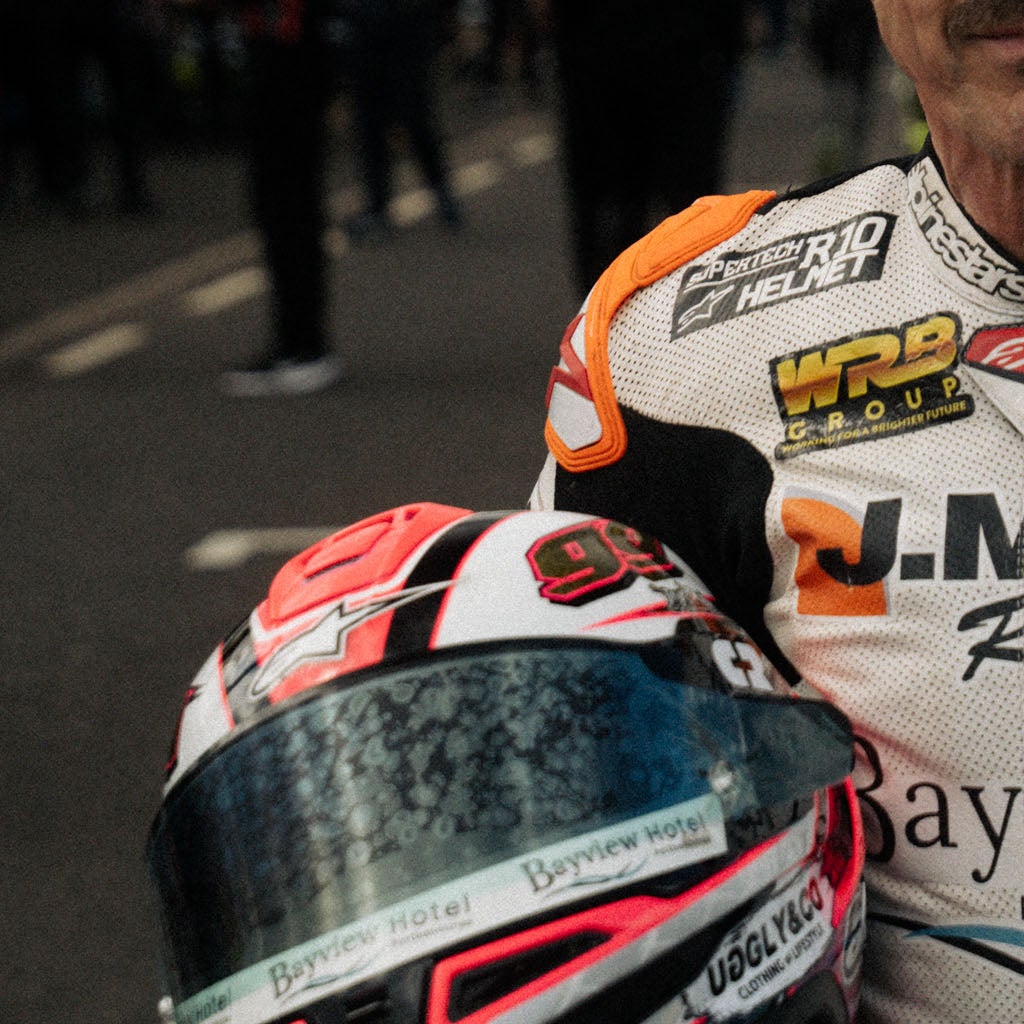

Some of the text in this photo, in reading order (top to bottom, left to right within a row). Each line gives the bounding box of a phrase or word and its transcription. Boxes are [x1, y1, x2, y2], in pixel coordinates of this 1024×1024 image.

[685, 216, 888, 288] SUPERTECH R10
[736, 248, 879, 312] HELMET
[776, 316, 957, 416] WRB
[781, 400, 967, 454] WORKING FOR A BRIGHTER FUTURE
[788, 377, 959, 441] GROUP
[520, 829, 638, 892] Bayview
[644, 812, 707, 843] Hotel
[270, 926, 376, 999] Bayview
[389, 893, 472, 934] Hotel
[737, 960, 786, 1000] CLOTHING
